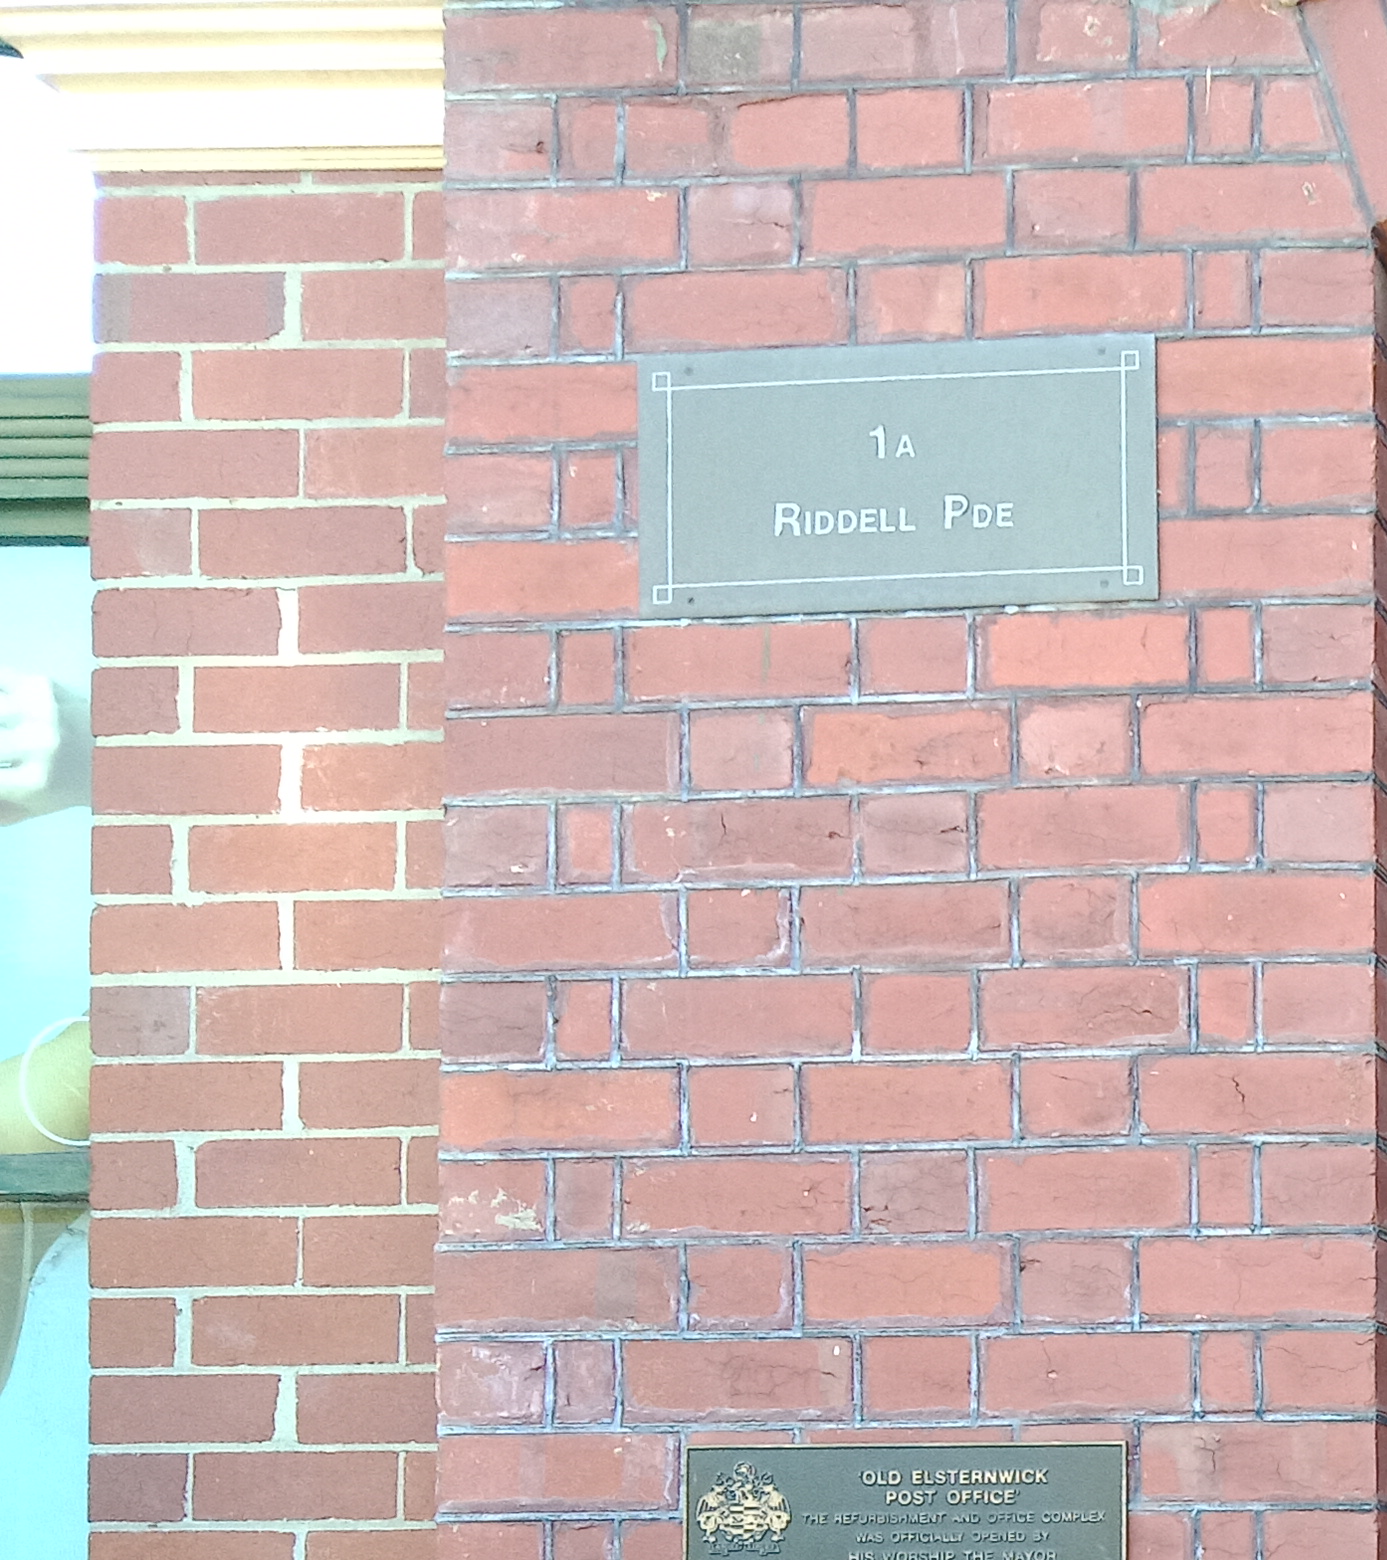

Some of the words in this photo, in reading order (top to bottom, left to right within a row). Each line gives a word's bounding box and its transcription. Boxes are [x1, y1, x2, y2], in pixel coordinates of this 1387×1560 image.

[869, 424, 916, 459] 1A
[911, 1469, 1049, 1486] ELSTERNWICK
[886, 1489, 937, 1505] POST
[802, 1511, 828, 1525] THE
[834, 1511, 946, 1525] REFURBISHMENT
[953, 1511, 980, 1525] AND
[987, 1511, 1035, 1525] OFFICE
[1041, 1511, 1106, 1525] COMPLEX
[856, 1531, 884, 1543] WAS
[891, 1531, 963, 1543] OFFICIALLY
[971, 1531, 1026, 1543] OPENED
[1033, 1531, 1049, 1543] BY
